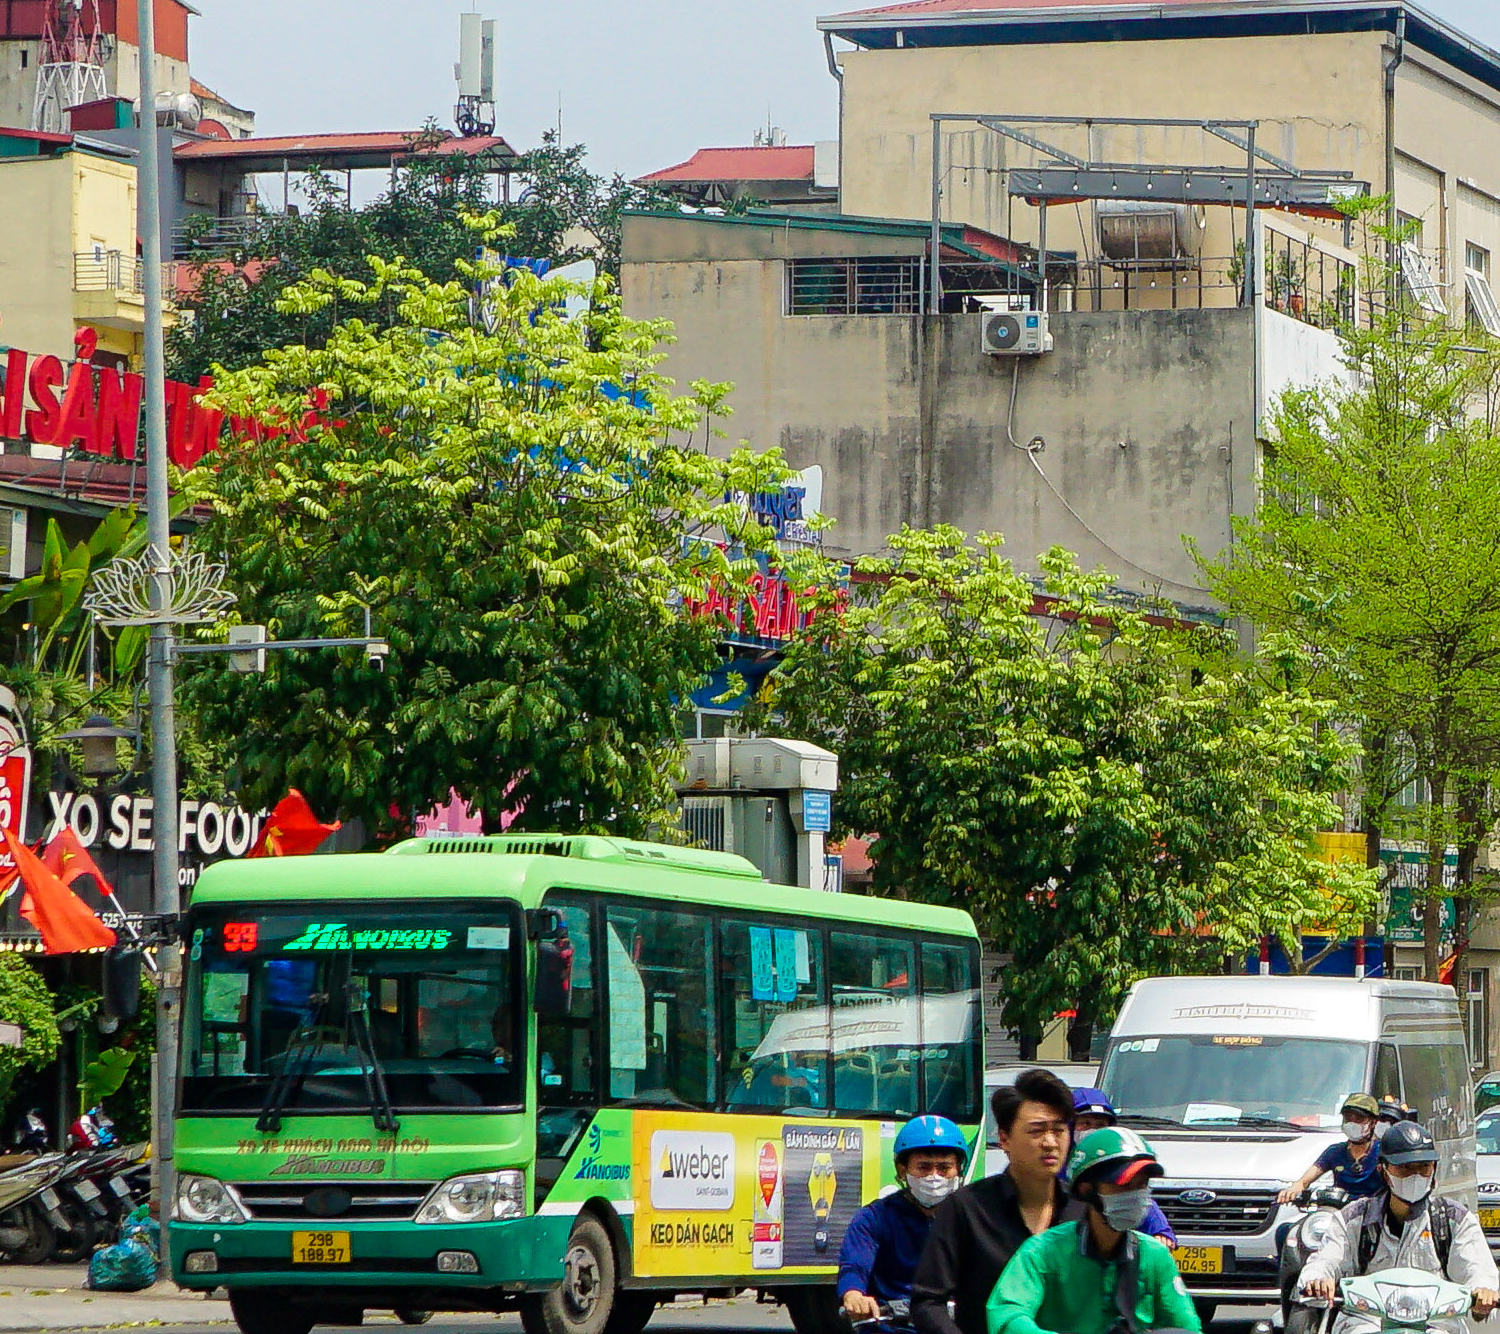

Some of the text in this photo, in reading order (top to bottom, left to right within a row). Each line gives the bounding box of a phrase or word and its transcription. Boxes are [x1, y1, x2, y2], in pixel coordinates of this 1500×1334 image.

[25, 326, 146, 461] SẢN
[836, 1128, 845, 1153] 4
[270, 1155, 385, 1175] HANOIBUS
[574, 1156, 630, 1180] HANOIBUS
[673, 1145, 728, 1179] weber
[308, 1233, 333, 1247] 29B
[650, 1218, 734, 1250] KEO DÁN GẠCH
[1184, 1247, 1206, 1259] 29G
